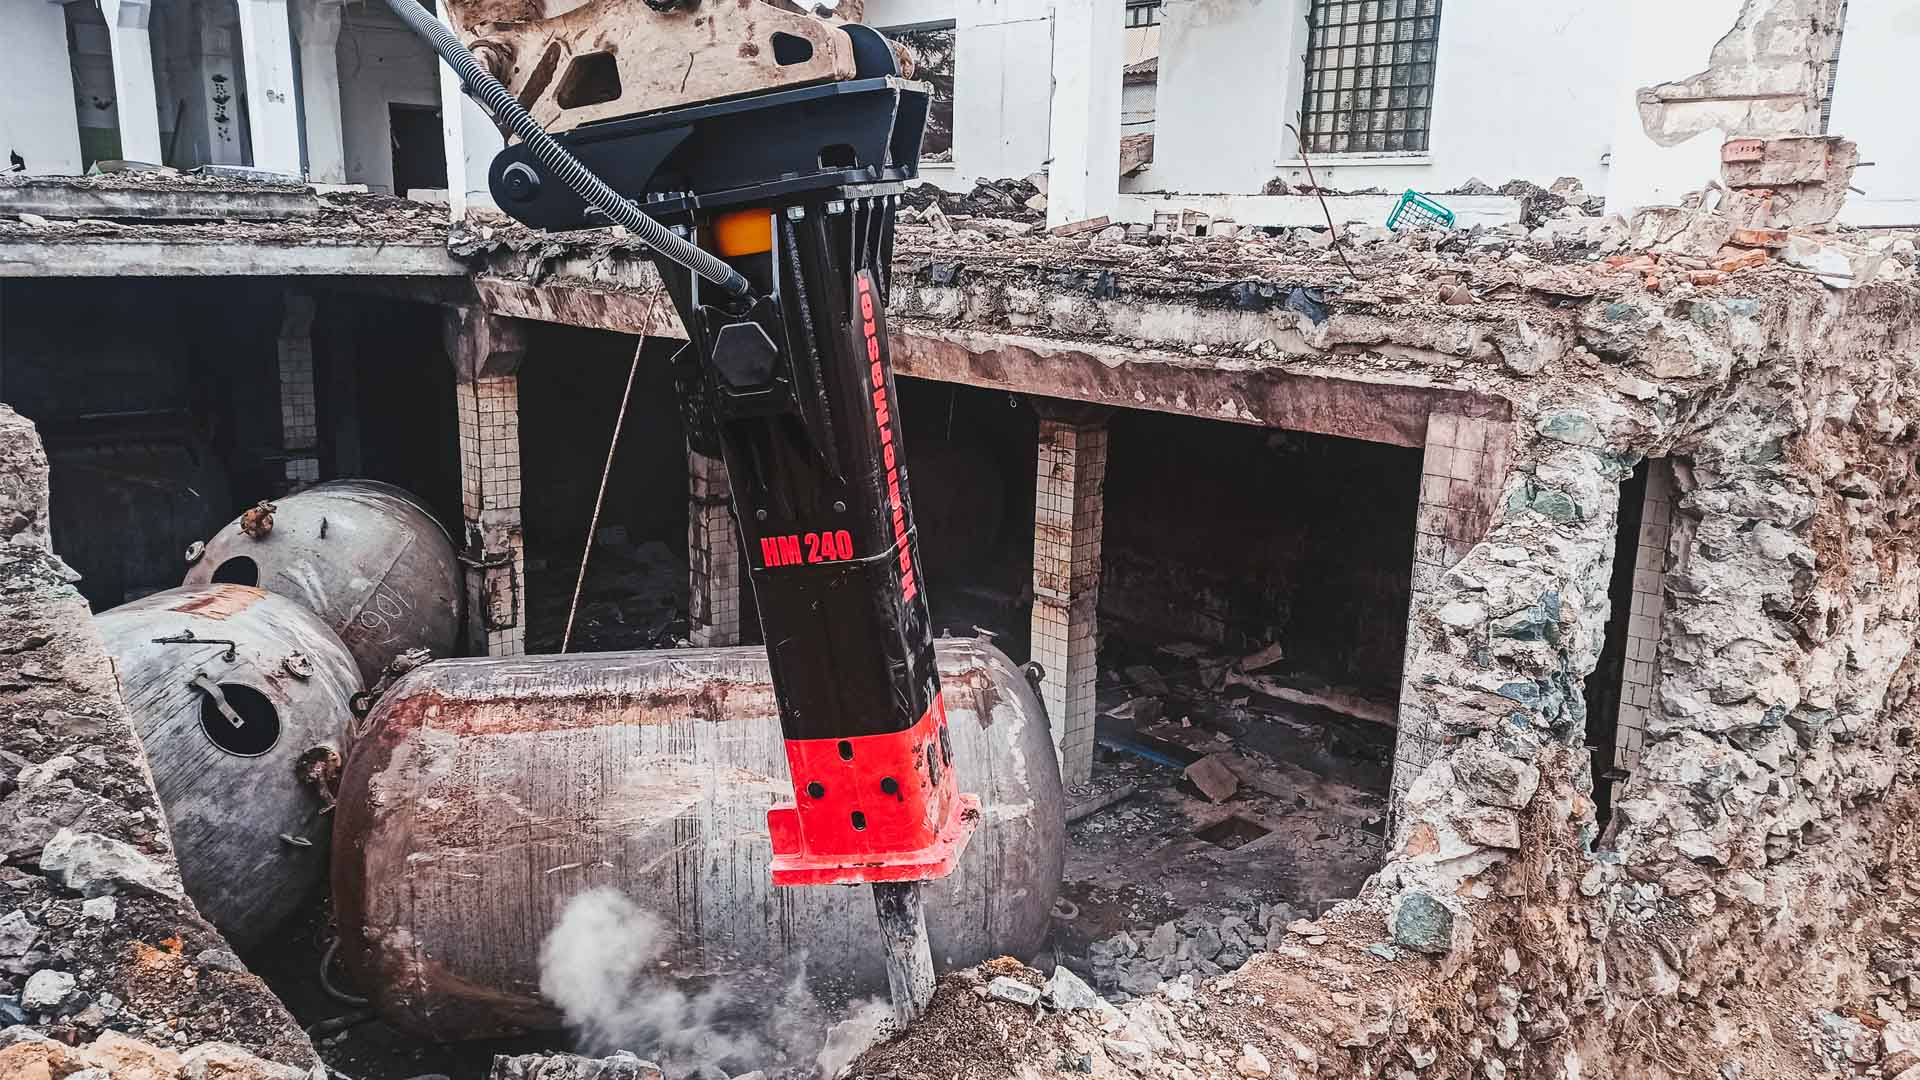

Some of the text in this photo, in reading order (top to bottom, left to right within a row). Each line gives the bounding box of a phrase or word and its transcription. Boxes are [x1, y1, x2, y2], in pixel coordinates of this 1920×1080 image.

[857, 276, 918, 602] HammerMaster
[760, 529, 854, 568] HM 240
